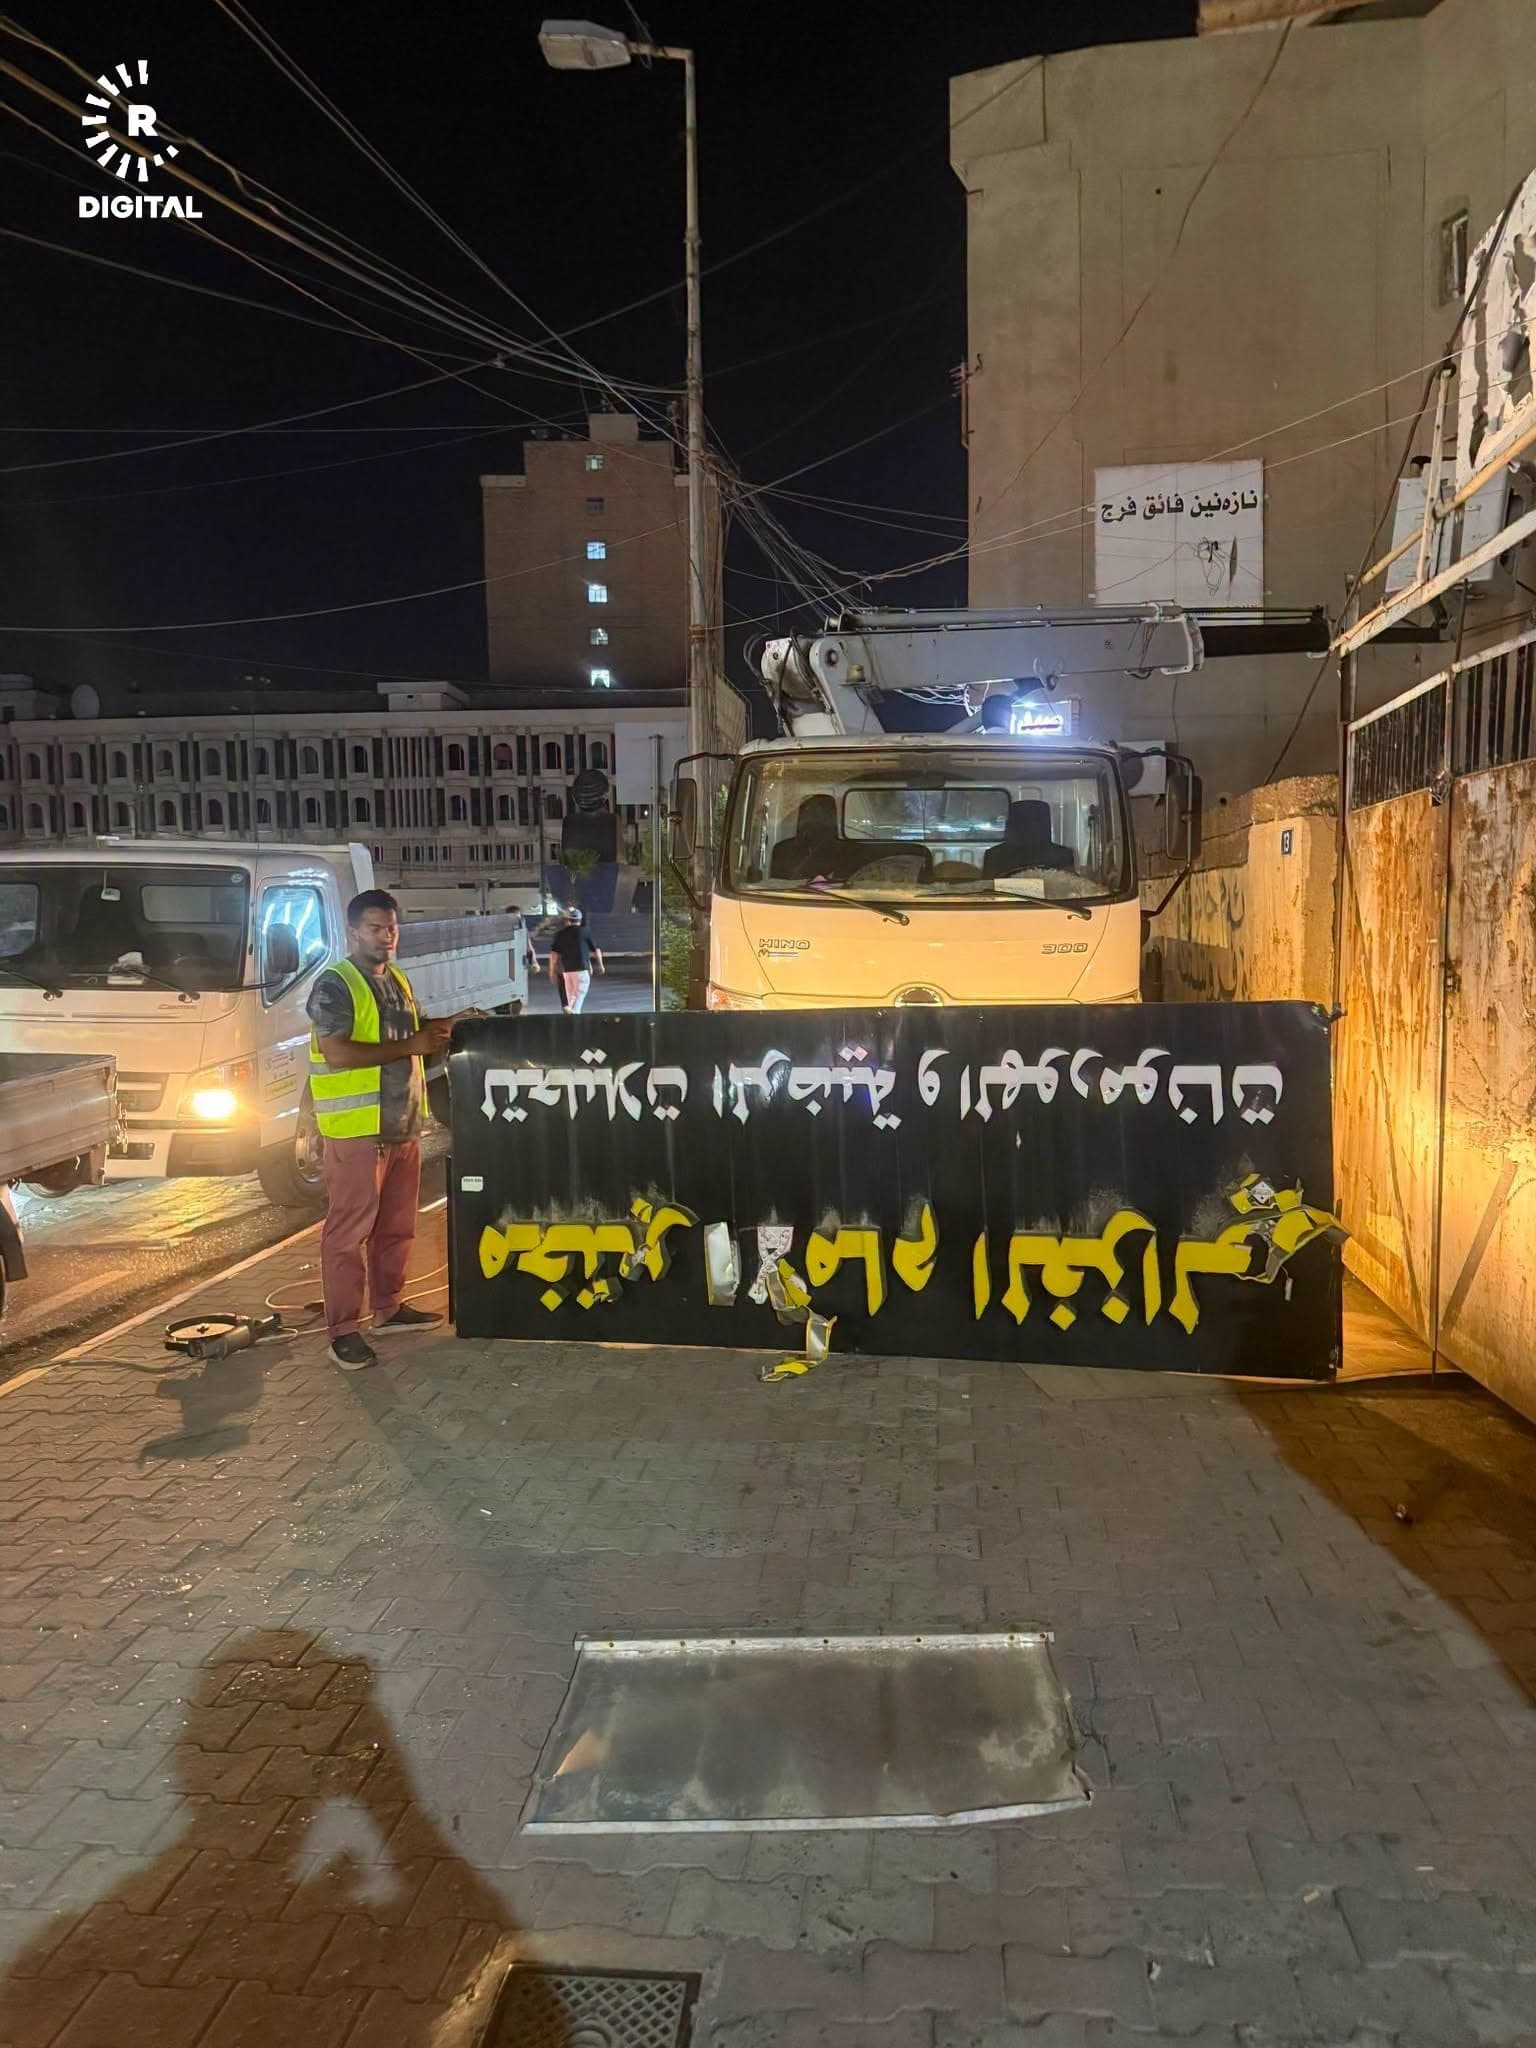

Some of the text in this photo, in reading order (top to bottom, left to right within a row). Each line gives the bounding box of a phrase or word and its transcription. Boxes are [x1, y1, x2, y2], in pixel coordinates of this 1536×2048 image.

[1101, 496, 1137, 523] فرج
[1142, 493, 1185, 521] فائق
[759, 938, 810, 950] HINO
[1041, 942, 1088, 955] 300
[960, 1048, 1284, 1125] الهورمونات
